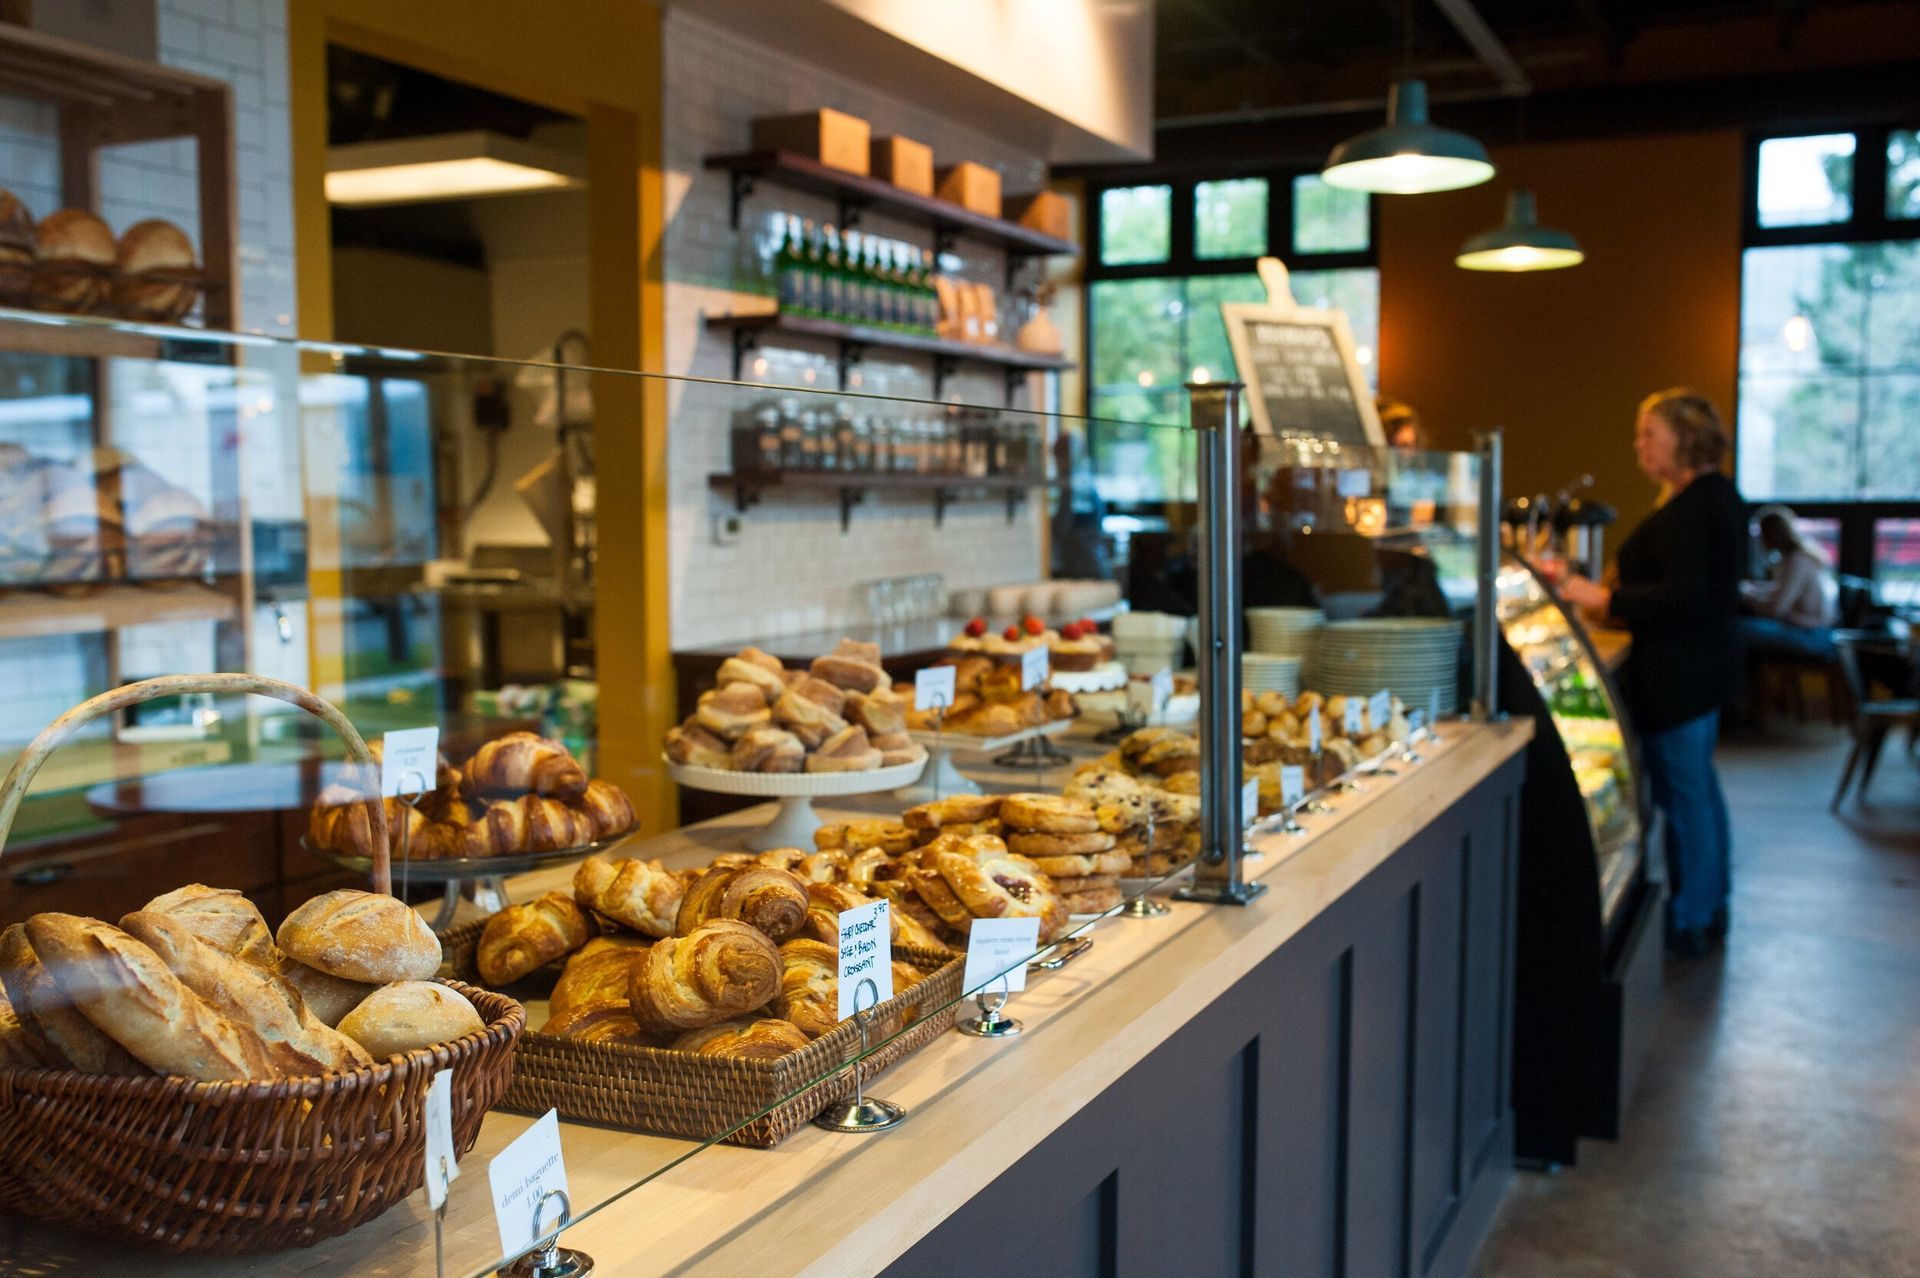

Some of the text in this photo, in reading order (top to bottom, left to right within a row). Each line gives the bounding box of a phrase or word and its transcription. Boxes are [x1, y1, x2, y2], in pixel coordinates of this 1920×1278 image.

[843, 956, 876, 978] CROISSANT
[502, 1153, 559, 1208] demi baguette
